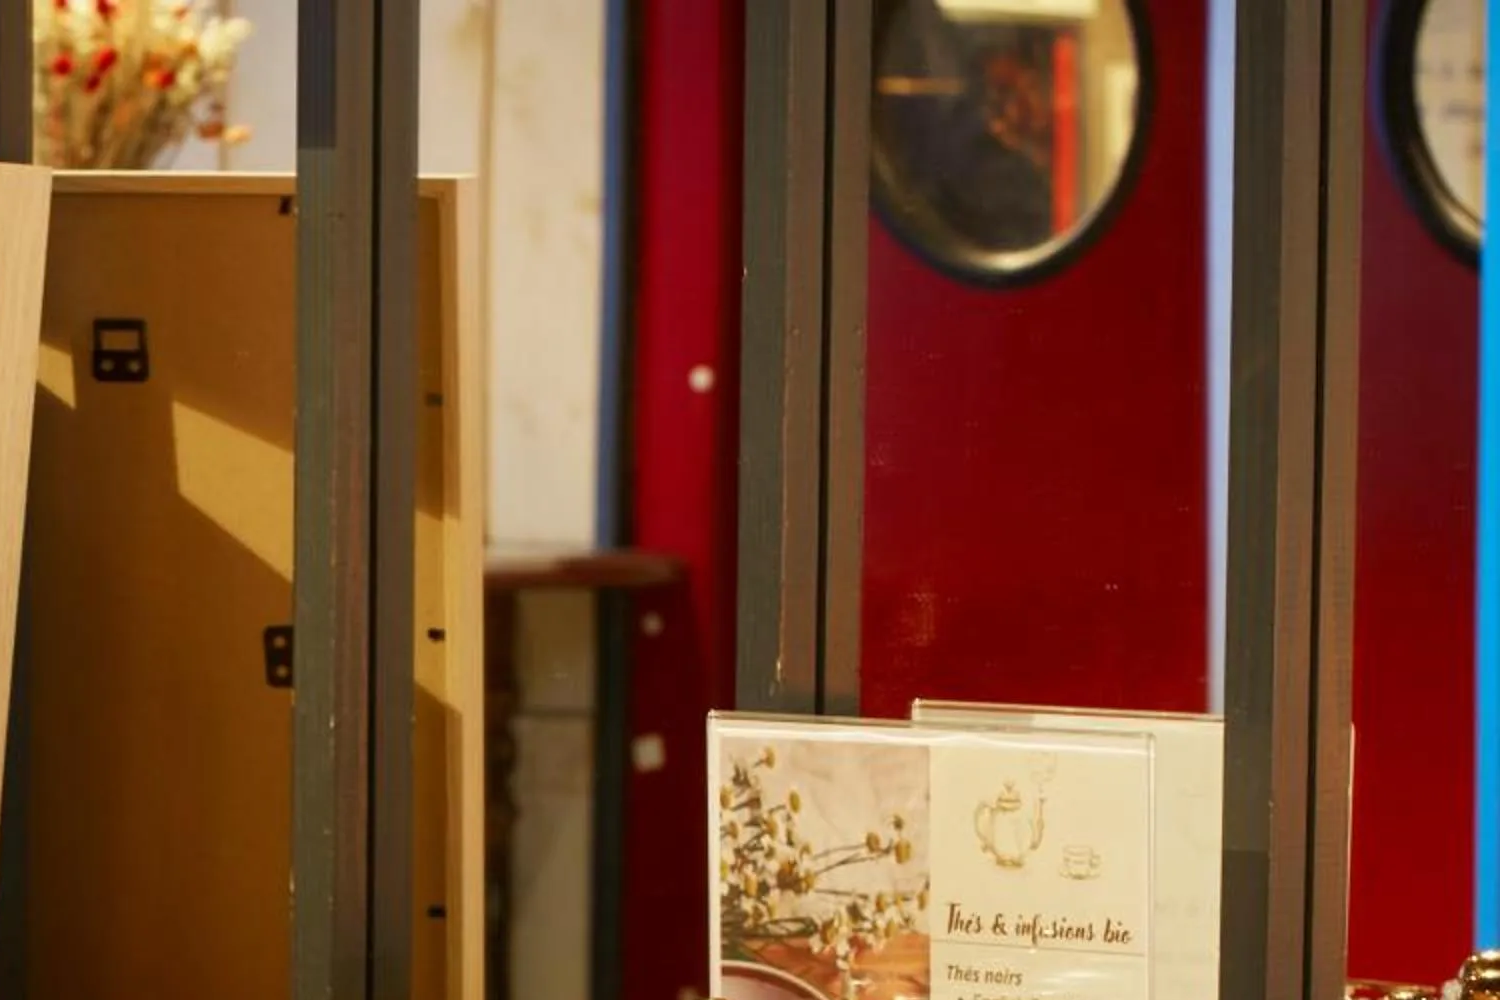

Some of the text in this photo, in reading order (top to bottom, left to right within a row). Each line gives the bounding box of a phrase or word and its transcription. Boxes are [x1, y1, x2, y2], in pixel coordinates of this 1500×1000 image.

[992, 912, 1007, 935] &
[1103, 917, 1132, 944] bio
[984, 967, 1023, 986] noirs
